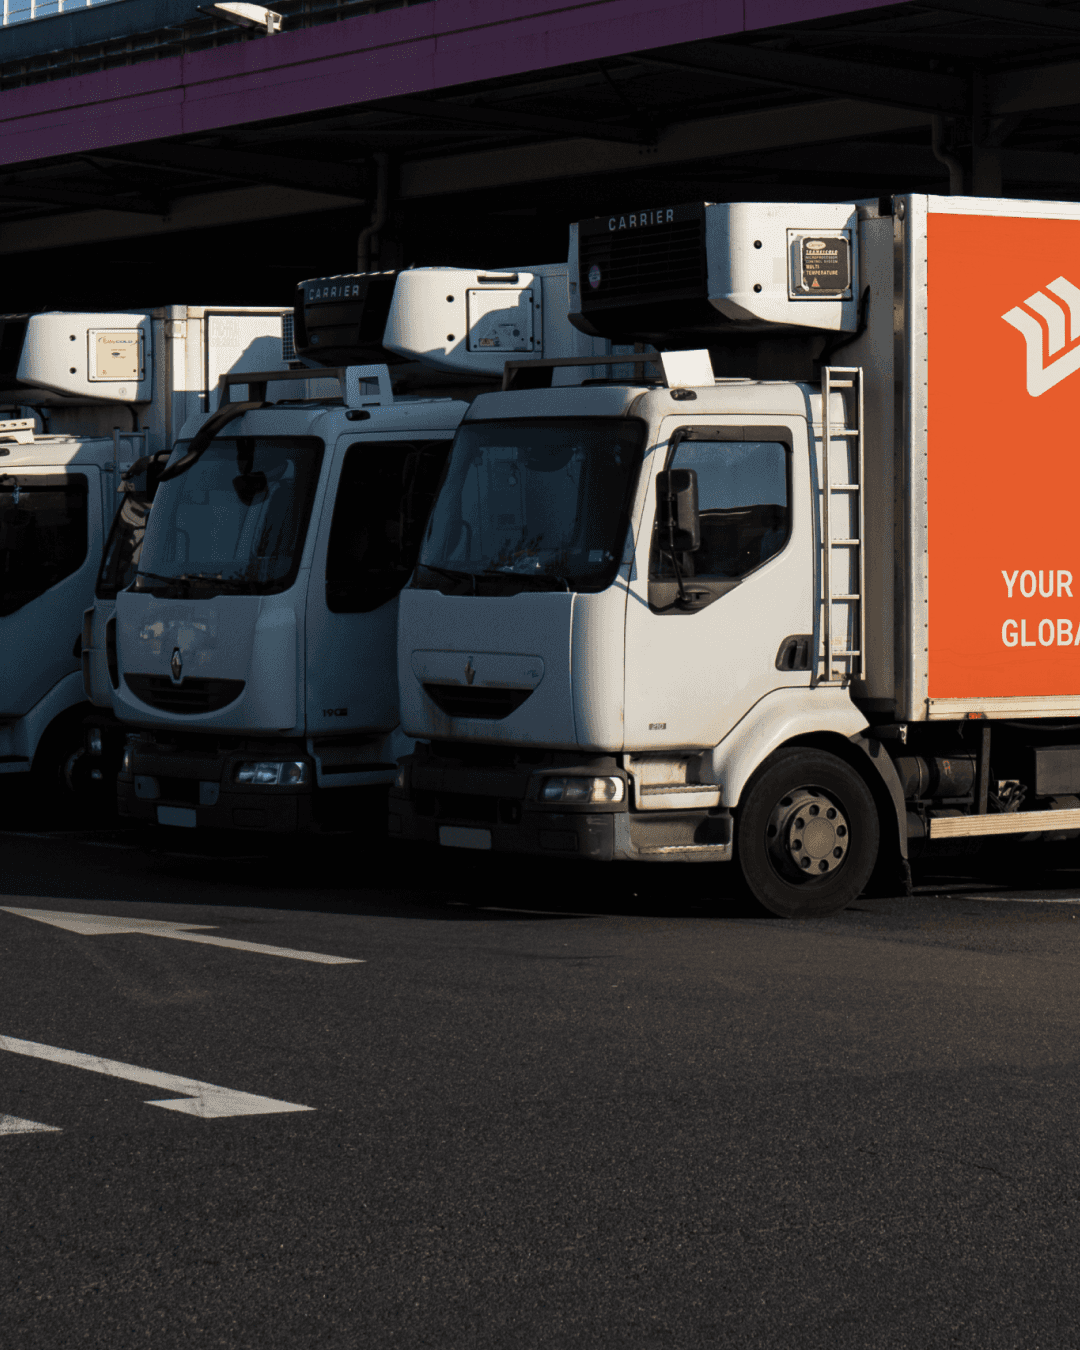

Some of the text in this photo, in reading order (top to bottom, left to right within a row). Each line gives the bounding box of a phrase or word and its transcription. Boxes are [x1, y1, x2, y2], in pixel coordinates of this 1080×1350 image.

[608, 208, 675, 231] CARRIER
[308, 284, 360, 301] CARRIER
[1001, 569, 1074, 598] YOUR
